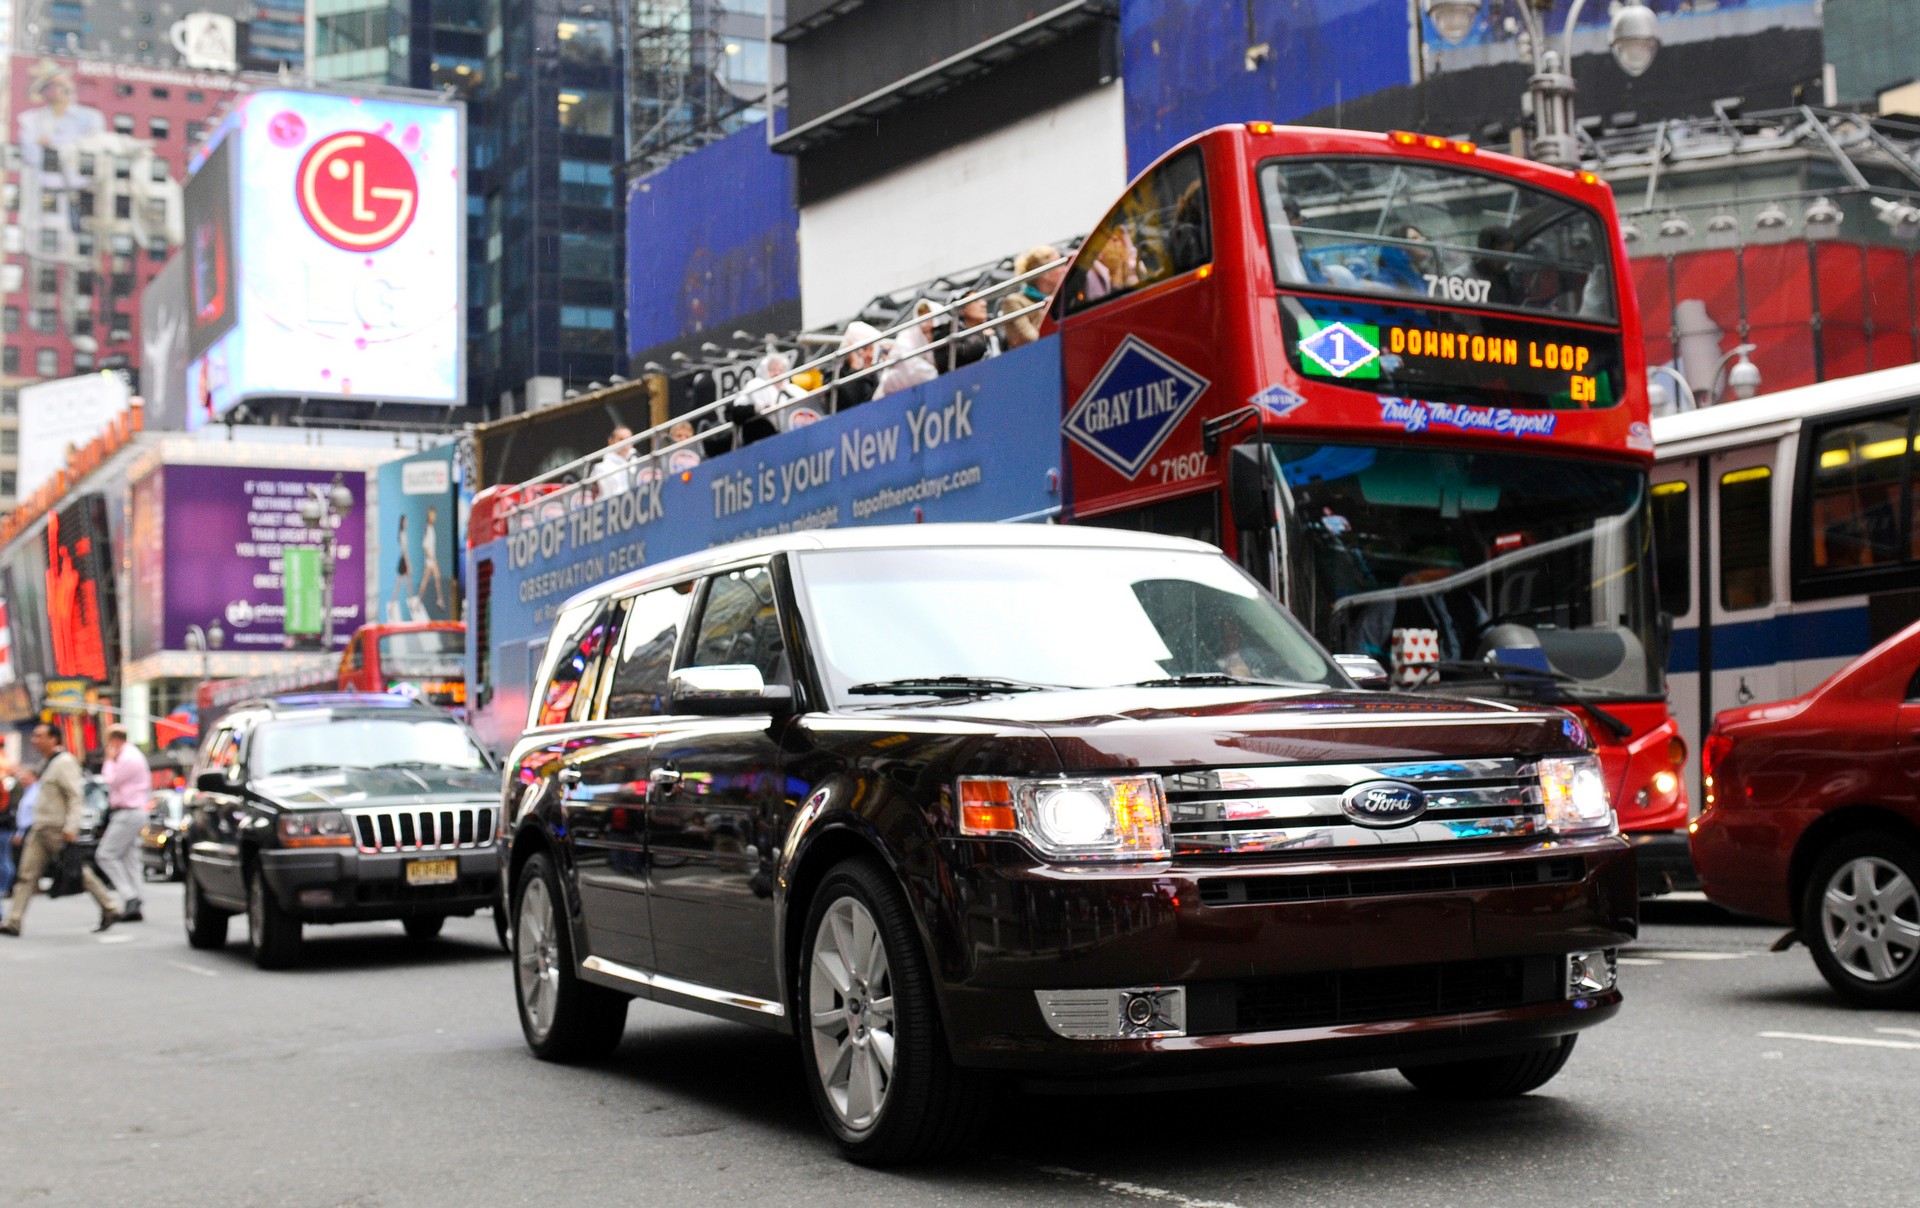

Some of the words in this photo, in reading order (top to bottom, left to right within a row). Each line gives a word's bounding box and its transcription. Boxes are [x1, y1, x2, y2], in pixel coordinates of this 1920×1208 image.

[304, 135, 414, 246] LG
[1423, 274, 1492, 303] 71607
[1328, 333, 1350, 366] 1
[1390, 327, 1518, 366] DOWNTOWN
[1529, 342, 1589, 372] LOOP
[1084, 390, 1134, 433] GRAY
[1136, 377, 1179, 420] LINE
[1570, 375, 1597, 402] EM
[1377, 396, 1428, 432] Truly,
[1426, 402, 1453, 422] The
[1453, 404, 1495, 428] Local
[1494, 409, 1555, 437] Expert!
[710, 470, 753, 519] This
[758, 463, 775, 503] is
[781, 448, 835, 505] your
[840, 425, 899, 476] New
[906, 390, 973, 453] York
[1160, 451, 1208, 484] 71607
[853, 465, 981, 518] topoftherocknyc.com
[506, 528, 539, 571] TOP
[541, 518, 566, 559] OF
[569, 502, 604, 549] THE
[607, 479, 664, 537] ROCK
[519, 555, 604, 602] OBSERVATION
[608, 541, 646, 575] DECK
[1365, 789, 1411, 812] Ford
